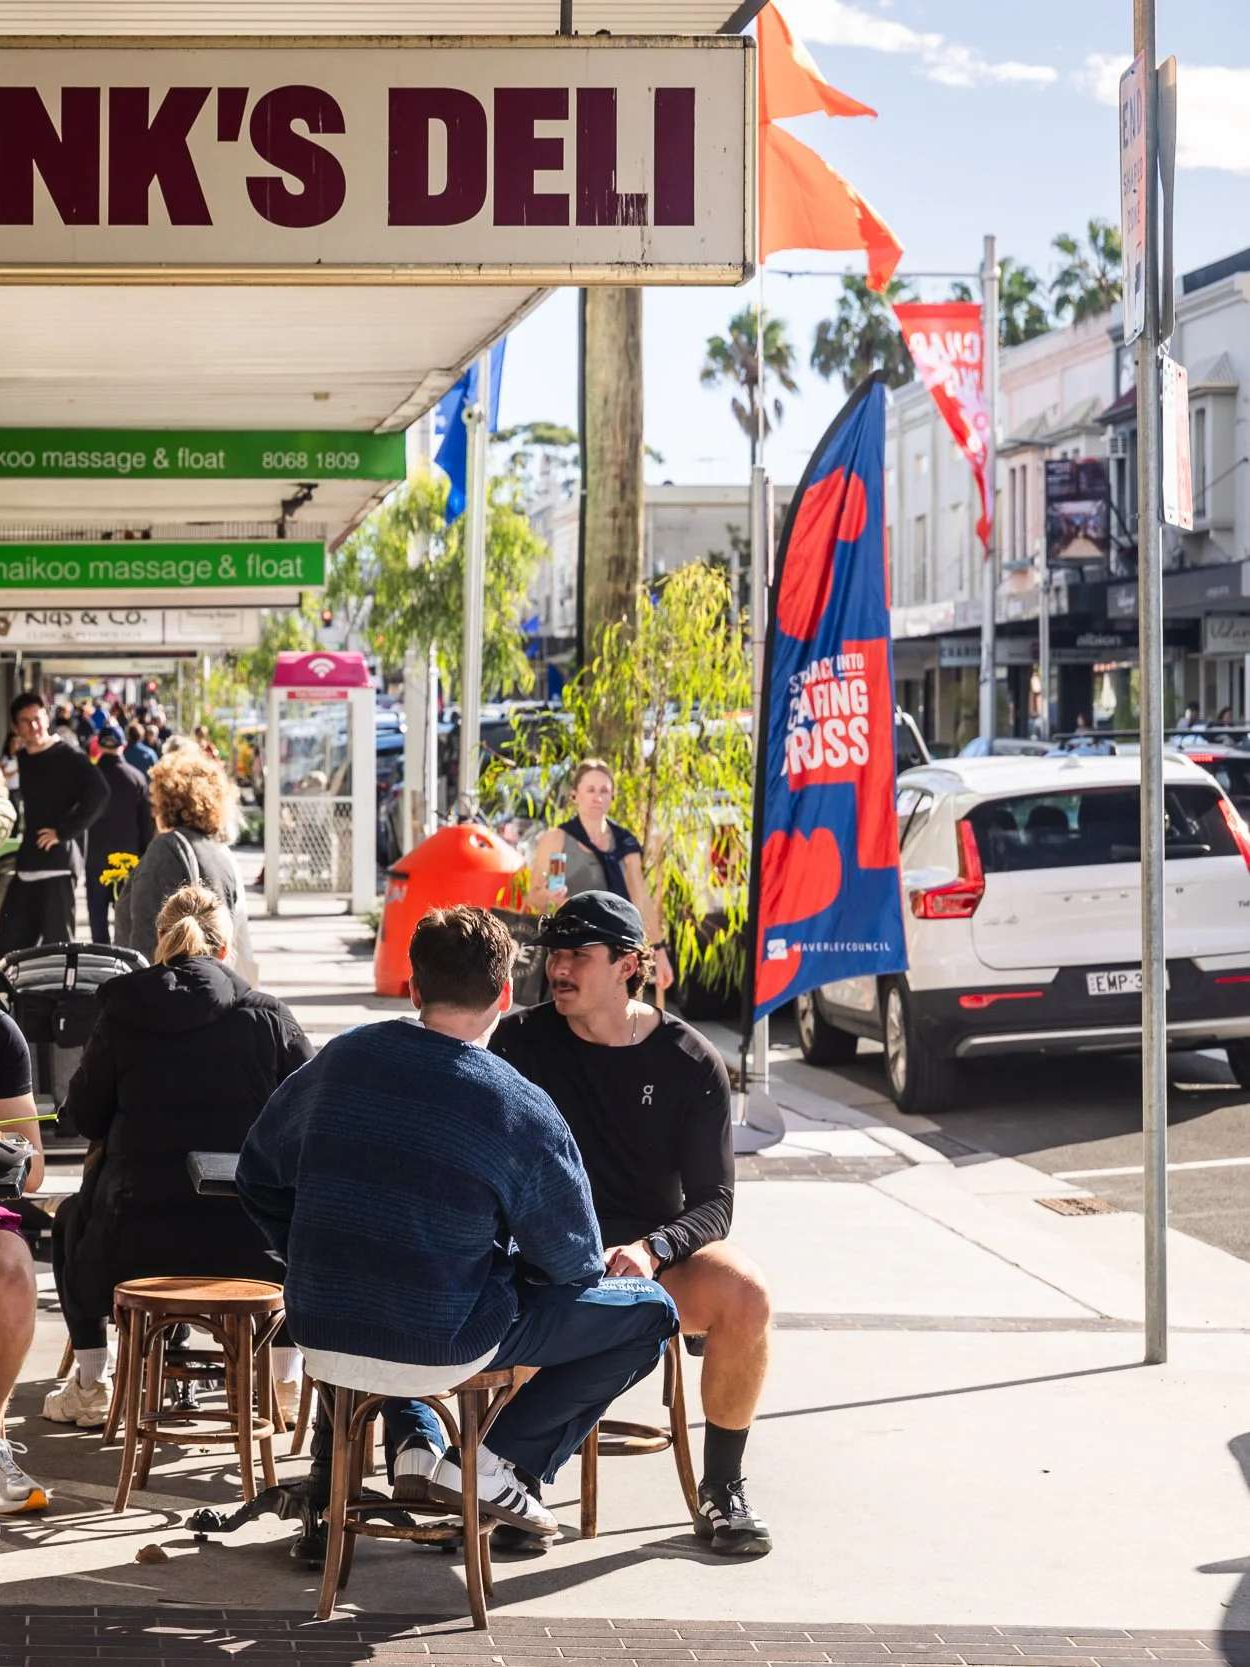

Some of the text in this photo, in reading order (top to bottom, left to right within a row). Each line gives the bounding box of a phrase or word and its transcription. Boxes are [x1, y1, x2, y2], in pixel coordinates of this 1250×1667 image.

[1123, 89, 1142, 149] END
[388, 87, 696, 226] DELI
[42, 450, 146, 472] massage
[153, 448, 170, 468] &
[177, 446, 225, 469] float
[262, 451, 308, 469] 8068
[315, 451, 360, 470] 1809
[89, 558, 211, 585] massage
[218, 556, 236, 579] &
[246, 554, 304, 579] float
[836, 653, 865, 672] INTO
